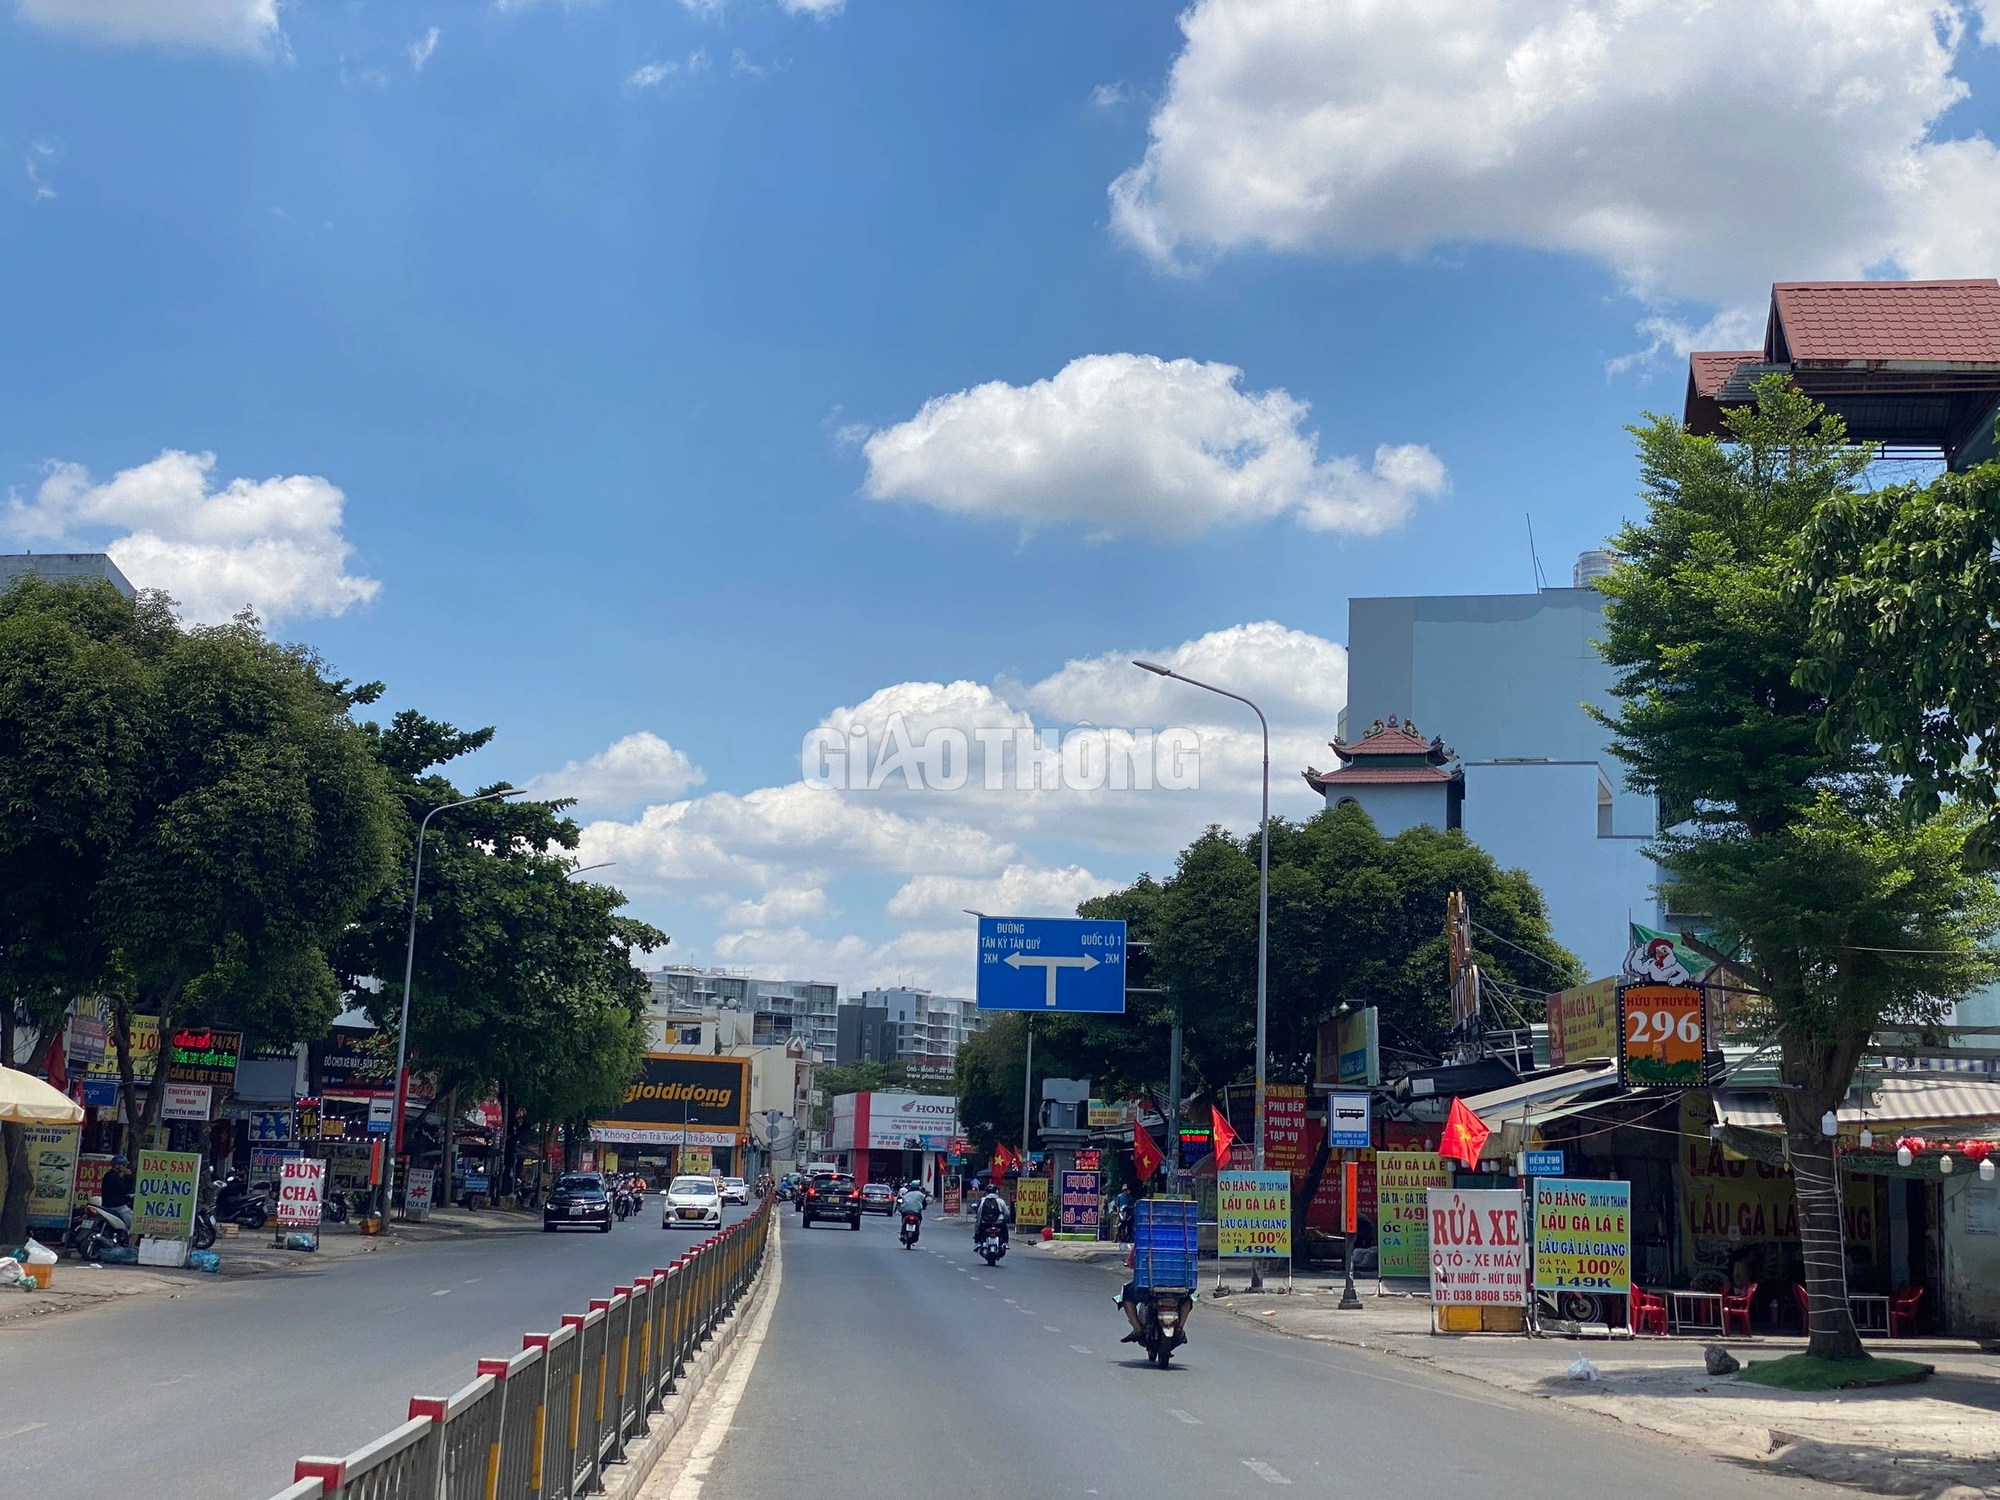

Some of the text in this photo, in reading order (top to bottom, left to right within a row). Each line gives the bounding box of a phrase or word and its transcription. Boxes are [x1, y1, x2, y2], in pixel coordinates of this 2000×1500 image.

[997, 921, 1025, 934] ĐƯỜNG
[981, 936, 1041, 950] TÂN KỲ TÂN QUÝ
[1081, 932, 1121, 948] QUỐC LỘ 1
[983, 953, 998, 964] 2KM
[1105, 954, 1120, 964] 2KM
[1626, 993, 1699, 1007] HỮU TRUYỀN
[1628, 1011, 1700, 1043] 296
[916, 1104, 955, 1114] HOND
[1268, 1100, 1304, 1114] PHỤ BẾP
[51, 1127, 71, 1135] TRUNG
[1269, 1117, 1305, 1130] PHỤC VỤ
[1269, 1131, 1298, 1143] TẠP VỤ
[143, 1156, 194, 1174] ĐẶC SẢN
[1381, 1156, 1401, 1170] LẨU
[1405, 1158, 1419, 1171] GÀ
[1423, 1158, 1436, 1171] LÁ
[1529, 1155, 1545, 1164] HẺM
[284, 1160, 321, 1179] BÚN
[140, 1174, 191, 1196] QUẢNG
[1067, 1174, 1095, 1191] PHỤ KIỆN
[1220, 1177, 1230, 1191] CÔ
[1233, 1175, 1256, 1191] HẰNG
[1381, 1170, 1395, 1186] LẨU
[1398, 1174, 1408, 1186] GÀ
[1411, 1174, 1420, 1186] LÁ
[1422, 1175, 1446, 1187] GIANG
[283, 1182, 318, 1201] CHẢ
[1018, 1185, 1046, 1202] ỐC CHẢO
[1064, 1191, 1098, 1206] NHÔM KÍNH
[1381, 1191, 1390, 1204] GÀ
[1392, 1193, 1399, 1204] TA
[1405, 1191, 1414, 1204] GÀ
[1538, 1185, 1628, 1211] CÔ HẰNG 300 TÂY THẠNH
[145, 1198, 182, 1217] NGÃI
[1222, 1194, 1286, 1210] LẨU GÀ LÁ É
[279, 1204, 318, 1217] Hà Nội
[1020, 1203, 1043, 1217] LẨU
[1063, 1208, 1075, 1223] GỖ
[1081, 1208, 1098, 1224] SẮT
[1393, 1207, 1428, 1220] 149
[1691, 1185, 1730, 1235] LẨU
[1737, 1194, 1766, 1236] GÀ
[1220, 1213, 1287, 1229] LẨU GÀ LÁ GIANG
[1383, 1221, 1401, 1233] ỐC
[1432, 1194, 1520, 1246] RỬA XE
[1541, 1209, 1624, 1233] LẨU GÀ LÁ É
[1250, 1232, 1286, 1244] 100%
[1383, 1236, 1401, 1246] GÀ
[1538, 1234, 1625, 1256] LẨU GÀ LÁ GIANG
[1433, 1250, 1522, 1267] Ô TÔ XE MÁY
[1577, 1259, 1625, 1276] 100%
[1458, 1270, 1480, 1284] NHỚT
[1488, 1271, 1505, 1285] HÚT
[1556, 1276, 1612, 1288] 149K
[1436, 1290, 1450, 1300] ĐT:
[1453, 1290, 1471, 1301] 038
[1475, 1290, 1500, 1301] 8808
